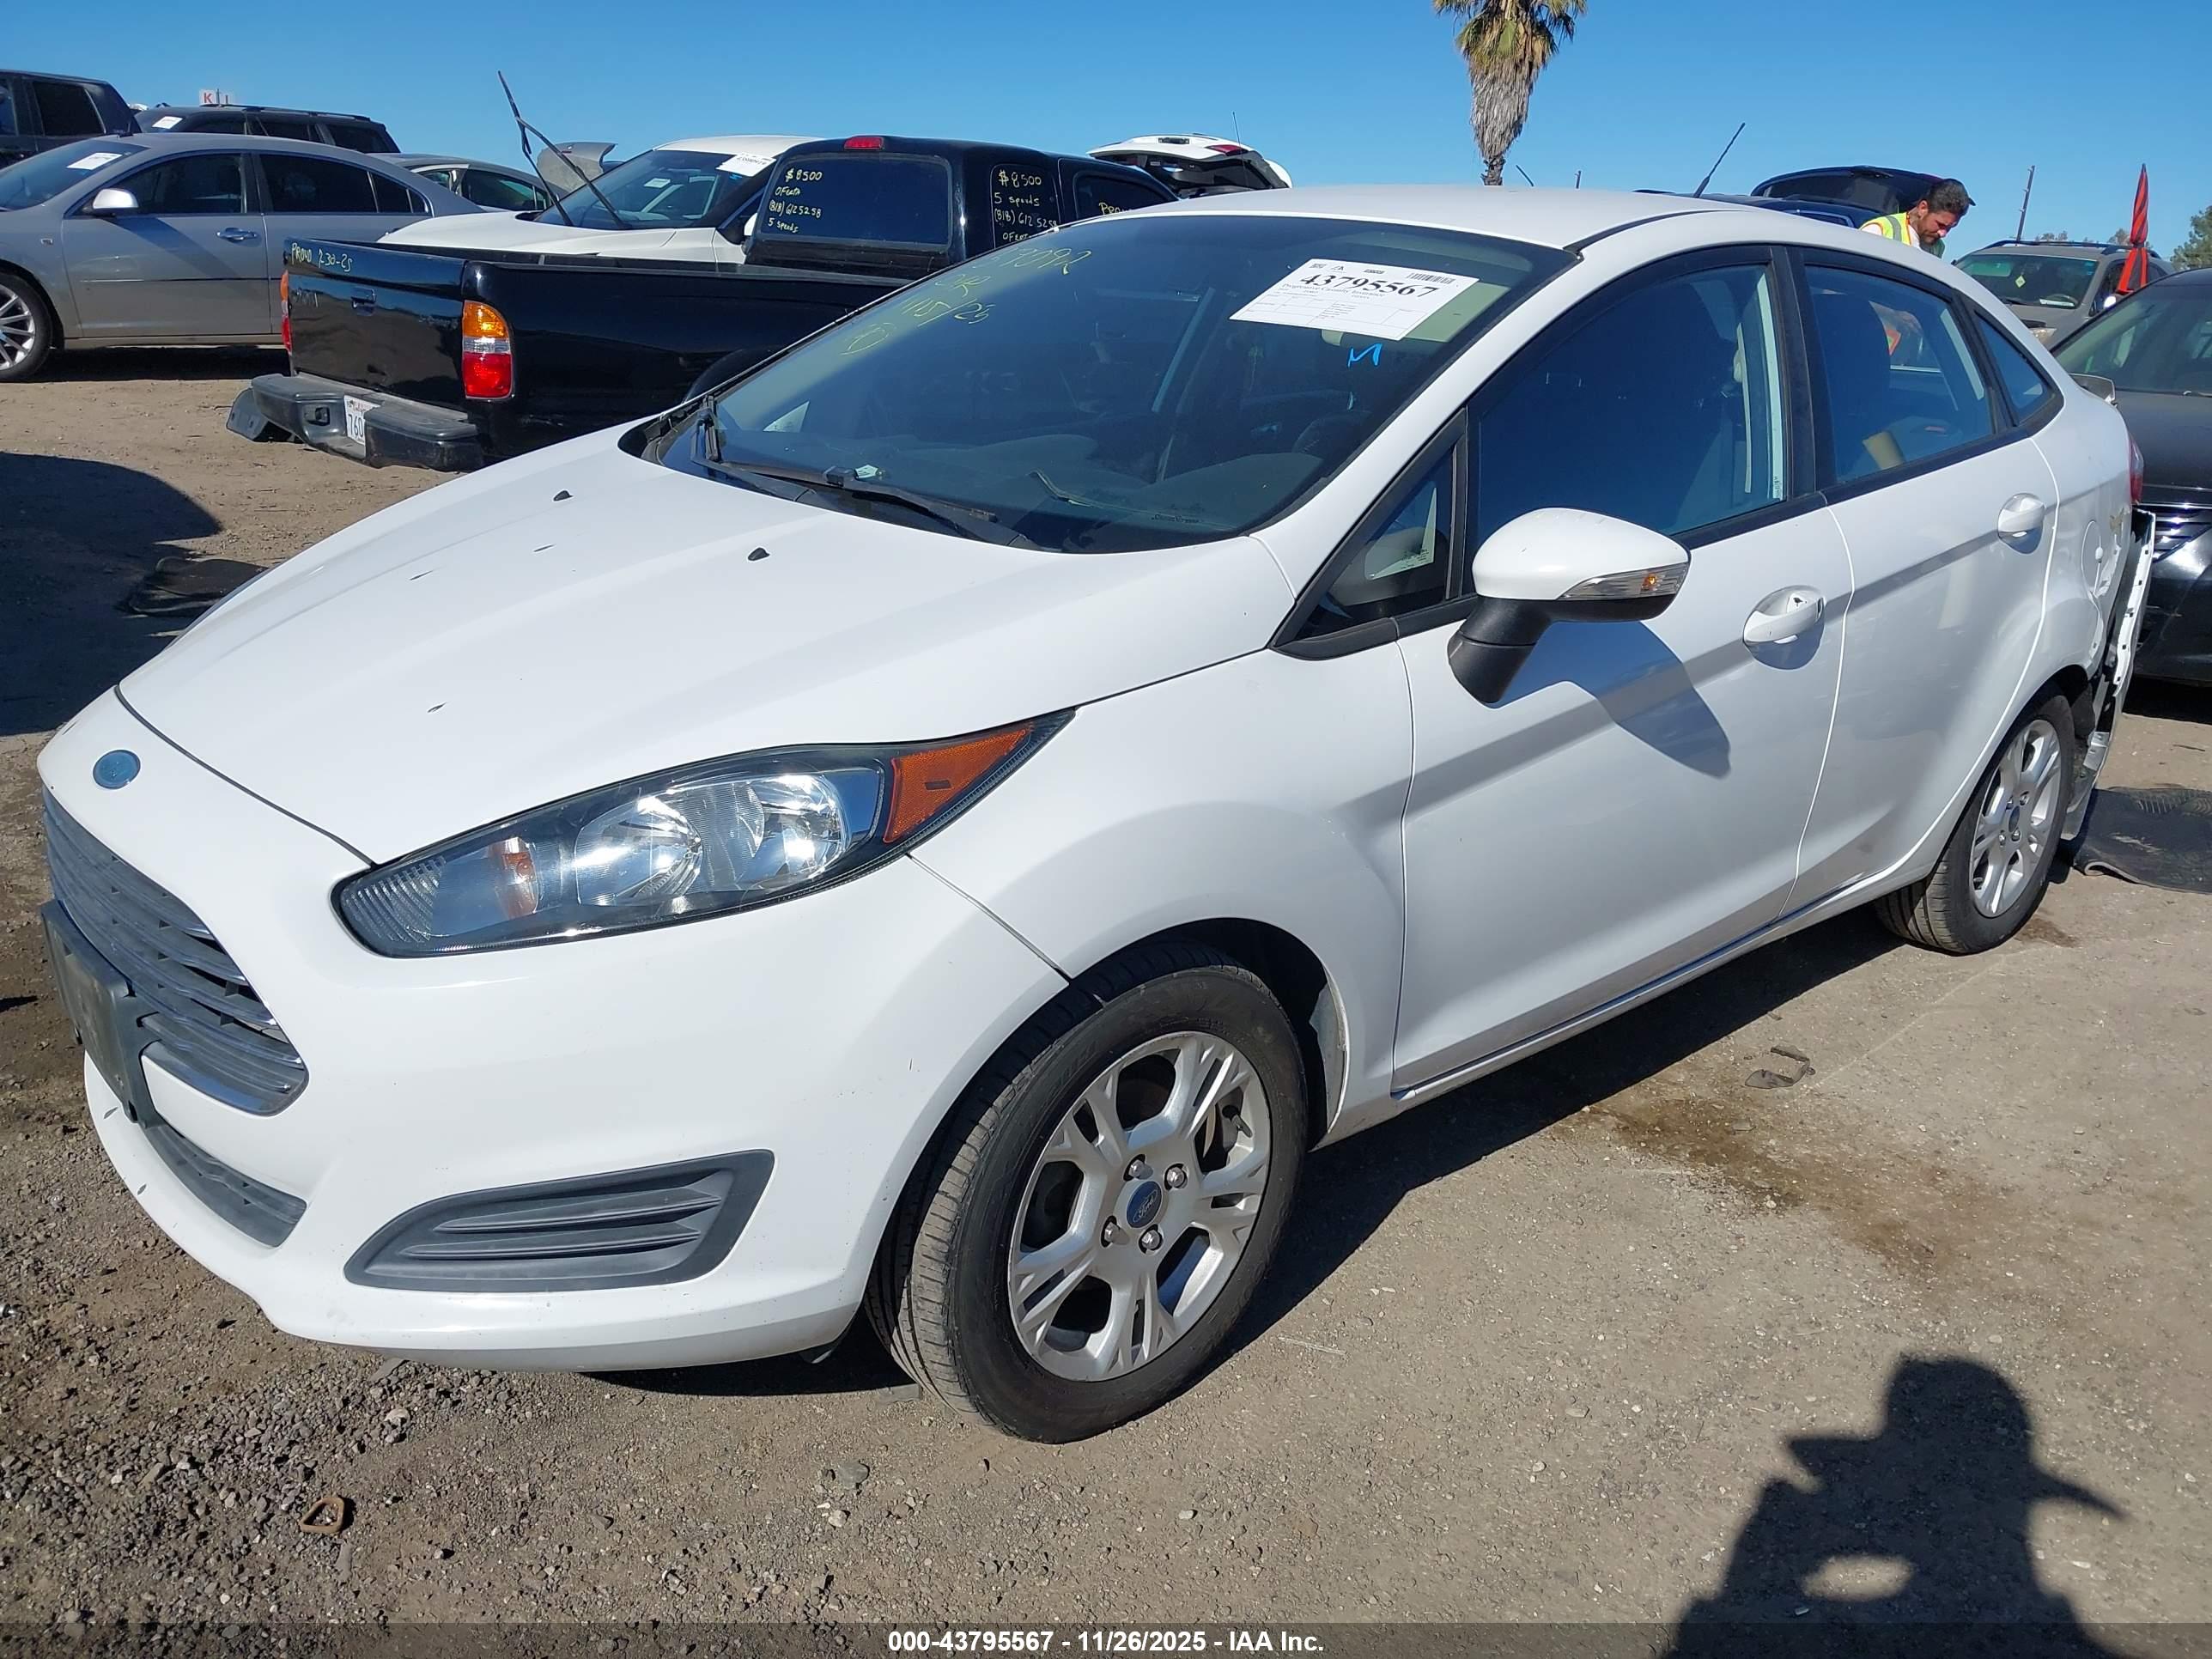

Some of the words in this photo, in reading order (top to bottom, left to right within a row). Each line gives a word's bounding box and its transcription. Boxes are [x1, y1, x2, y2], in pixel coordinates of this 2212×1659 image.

[994, 191, 1003, 204] 5
[768, 217, 775, 227] 5
[1300, 274, 1440, 298] 43795567
